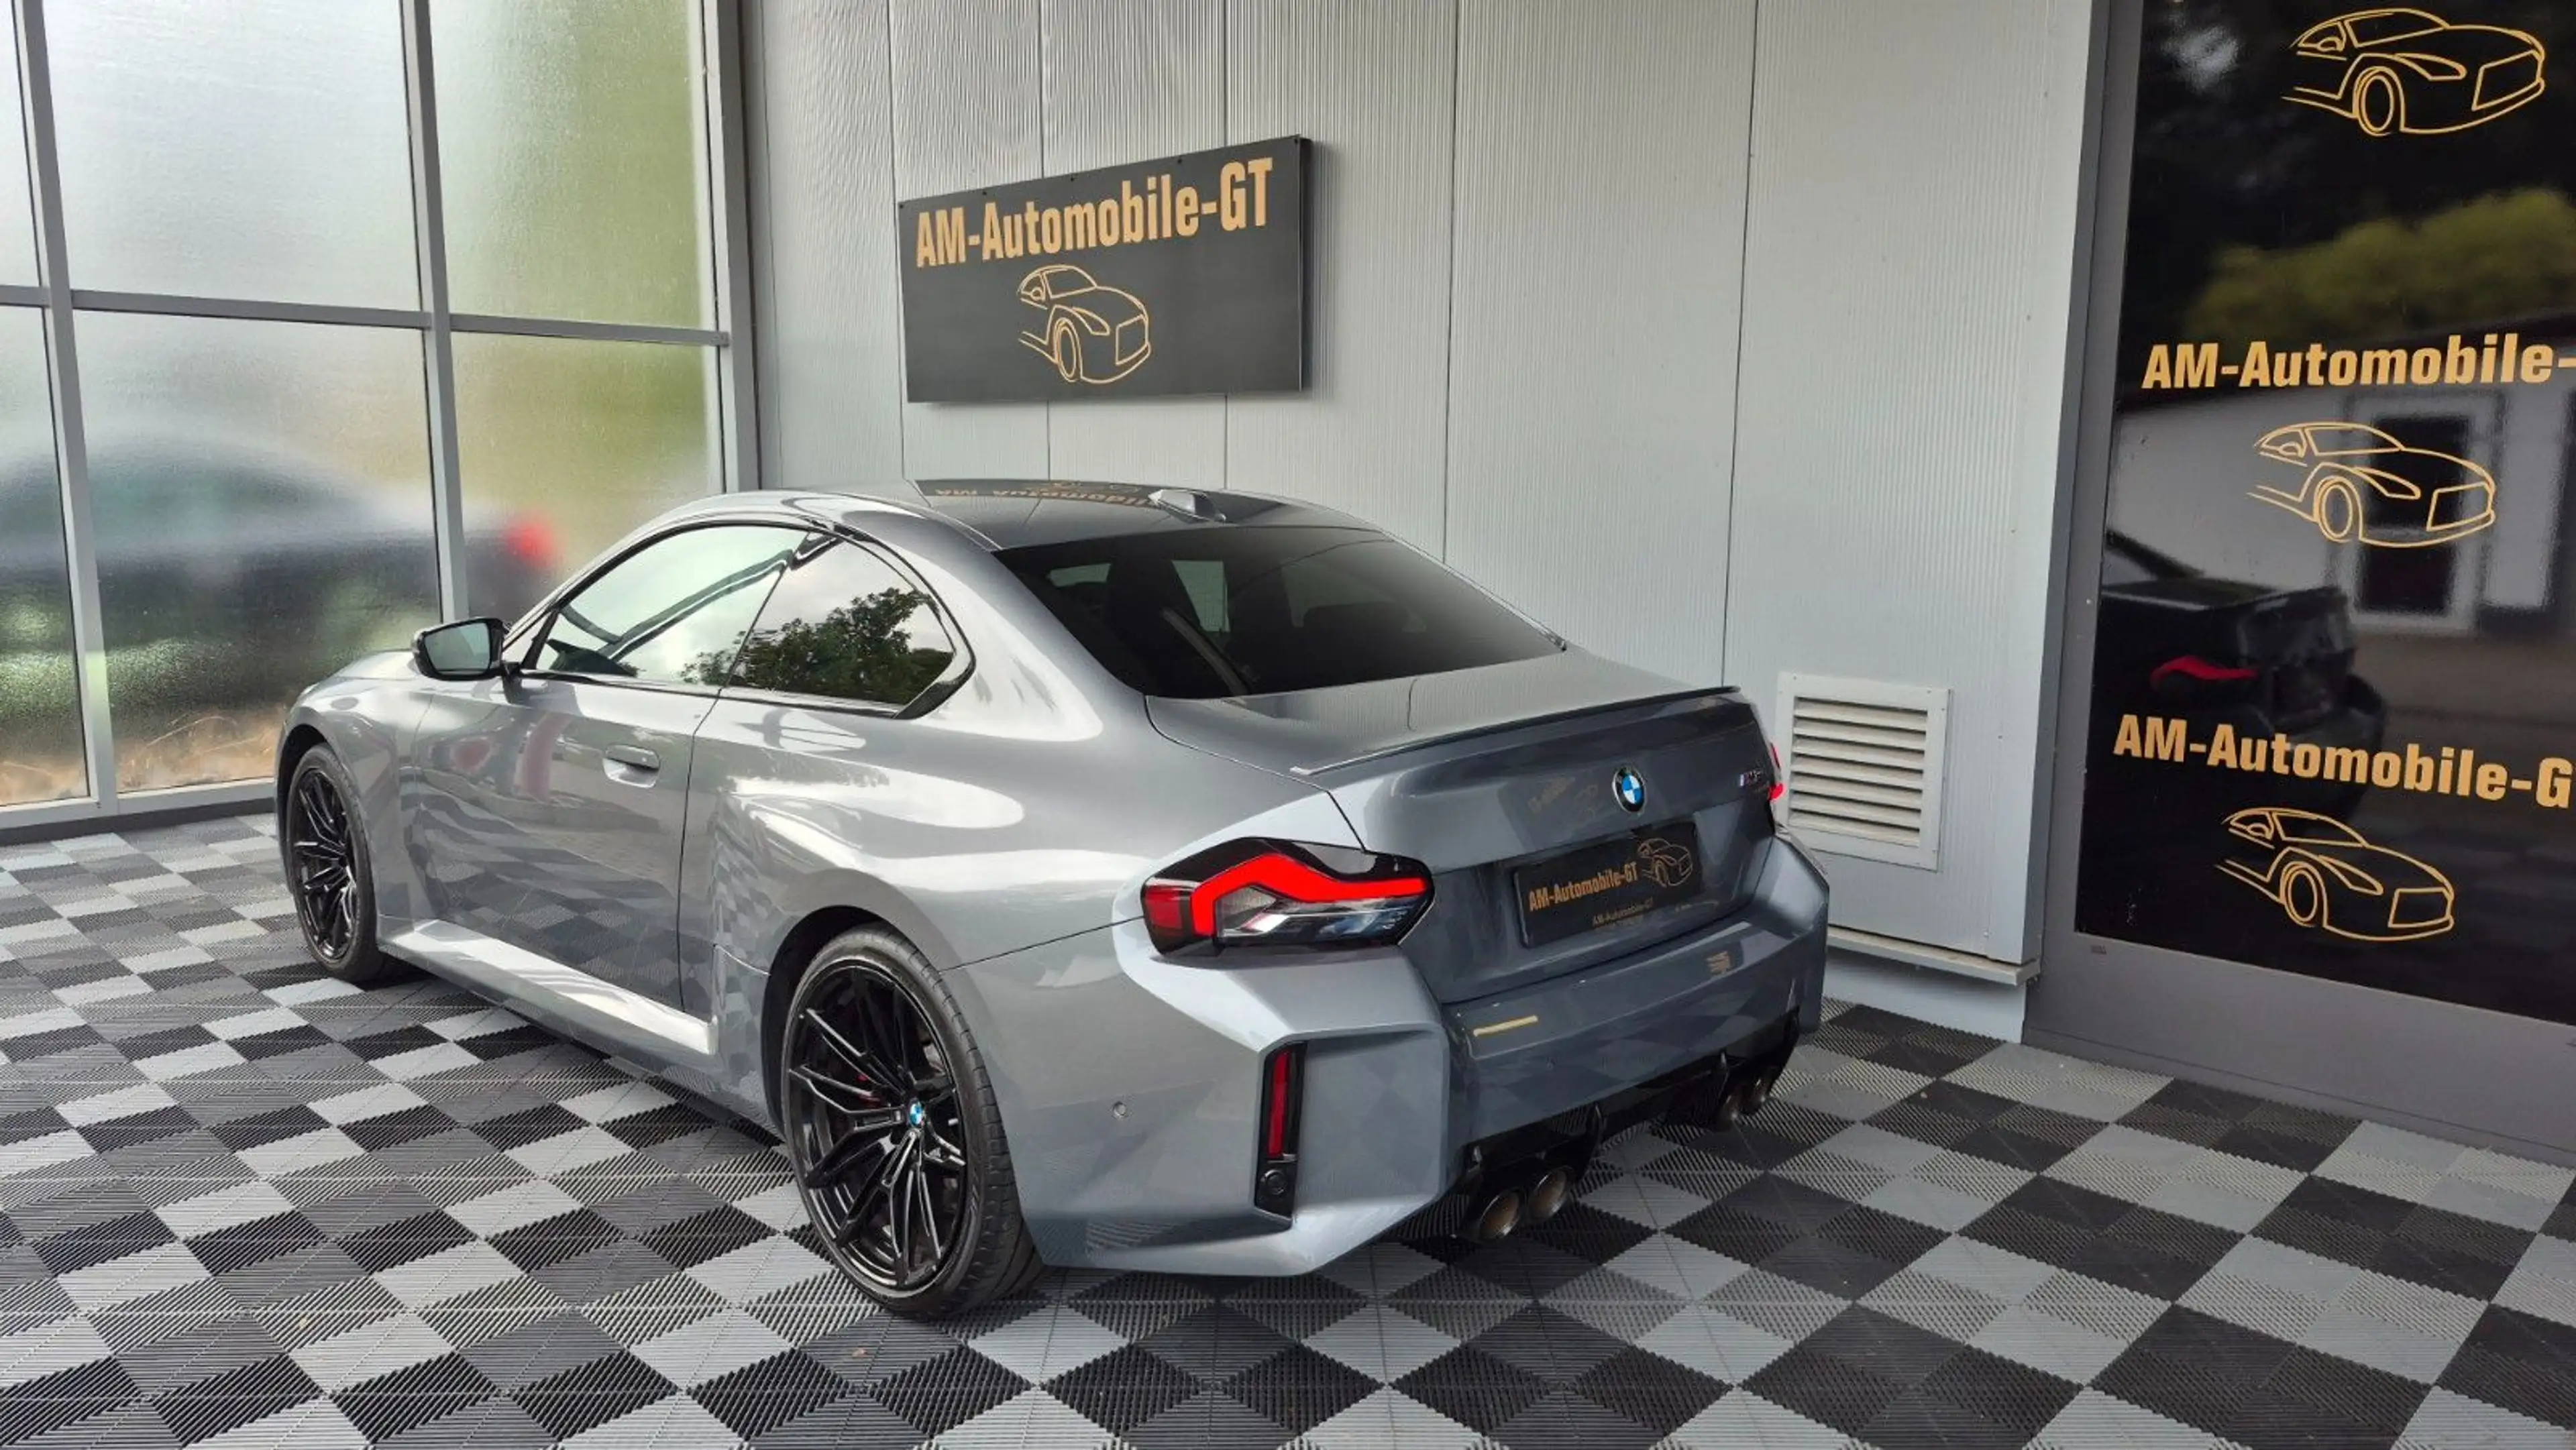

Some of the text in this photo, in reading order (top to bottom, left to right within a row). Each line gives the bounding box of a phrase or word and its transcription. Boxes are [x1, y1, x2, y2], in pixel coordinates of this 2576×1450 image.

[916, 158, 1272, 268] AM-Automobile-GT
[2114, 714, 2573, 808] AM-Automobile-G
[1529, 862, 1638, 911] AM-Automobile-GT
